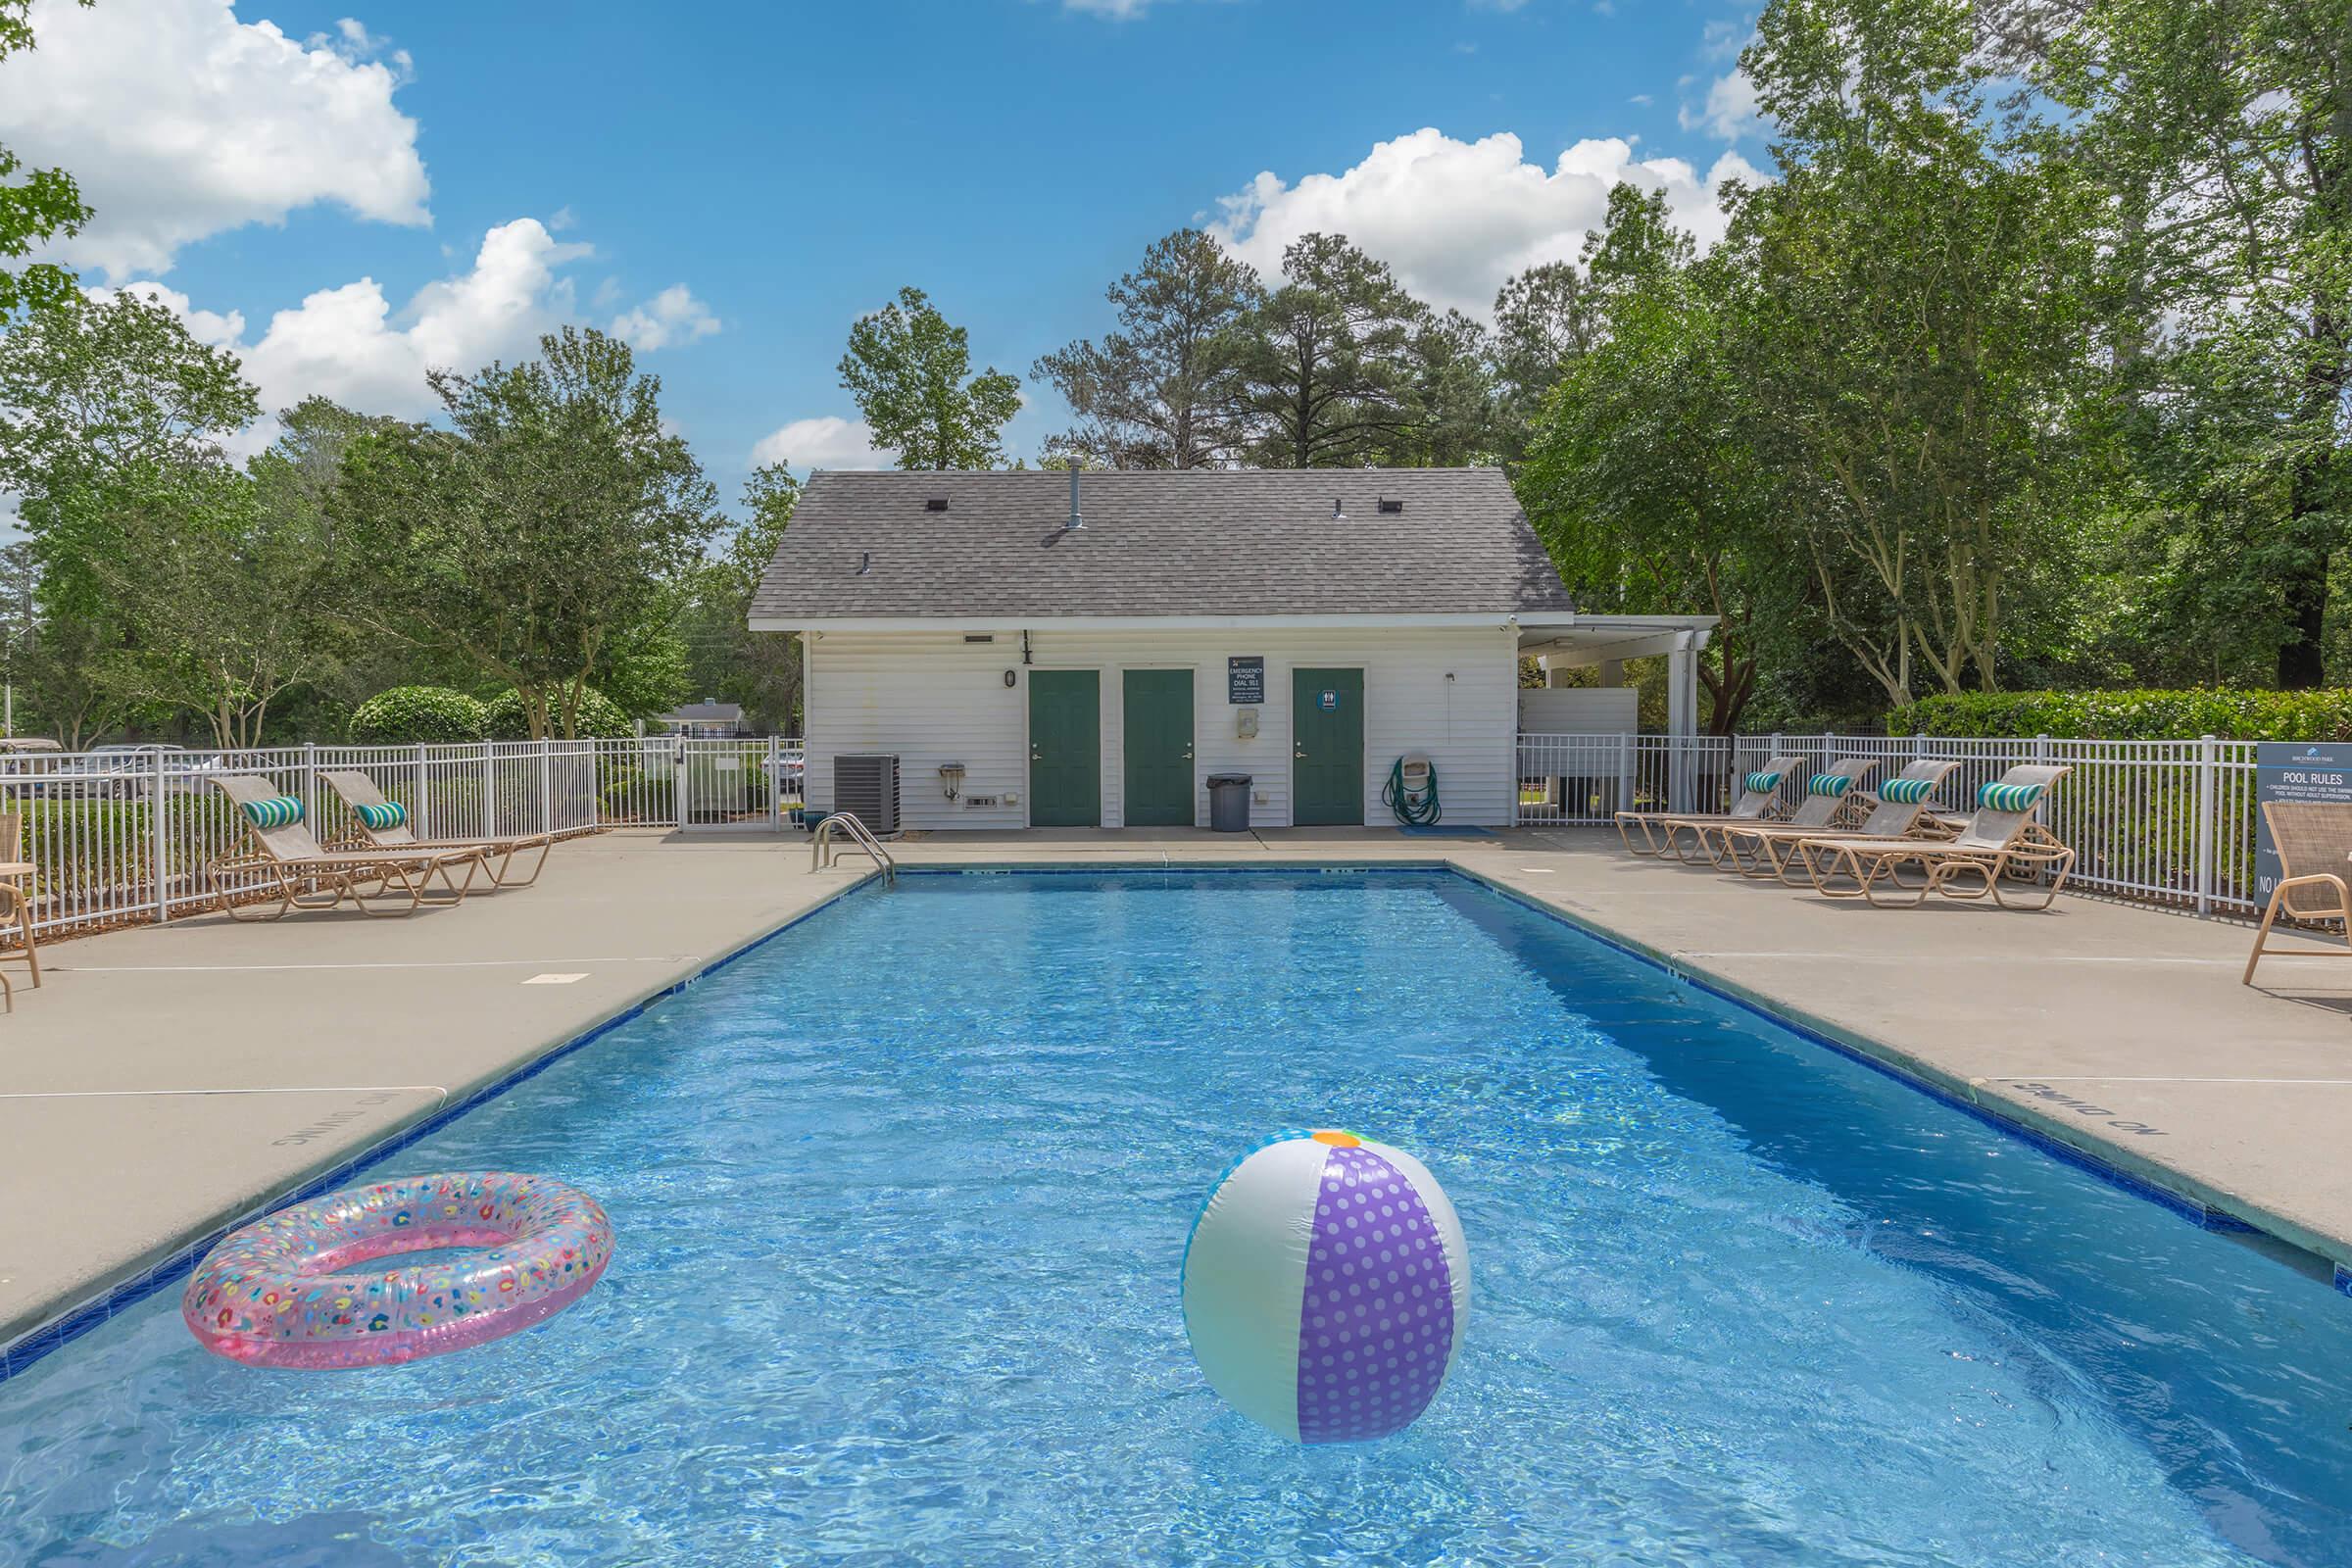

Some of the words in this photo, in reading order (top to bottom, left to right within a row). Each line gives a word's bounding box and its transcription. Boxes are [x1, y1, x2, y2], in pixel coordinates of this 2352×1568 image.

[2283, 771, 2308, 783] POOL
[2311, 773, 2342, 785] RULES
[2259, 875, 2272, 894] NO
[2107, 1121, 2171, 1136] NO
